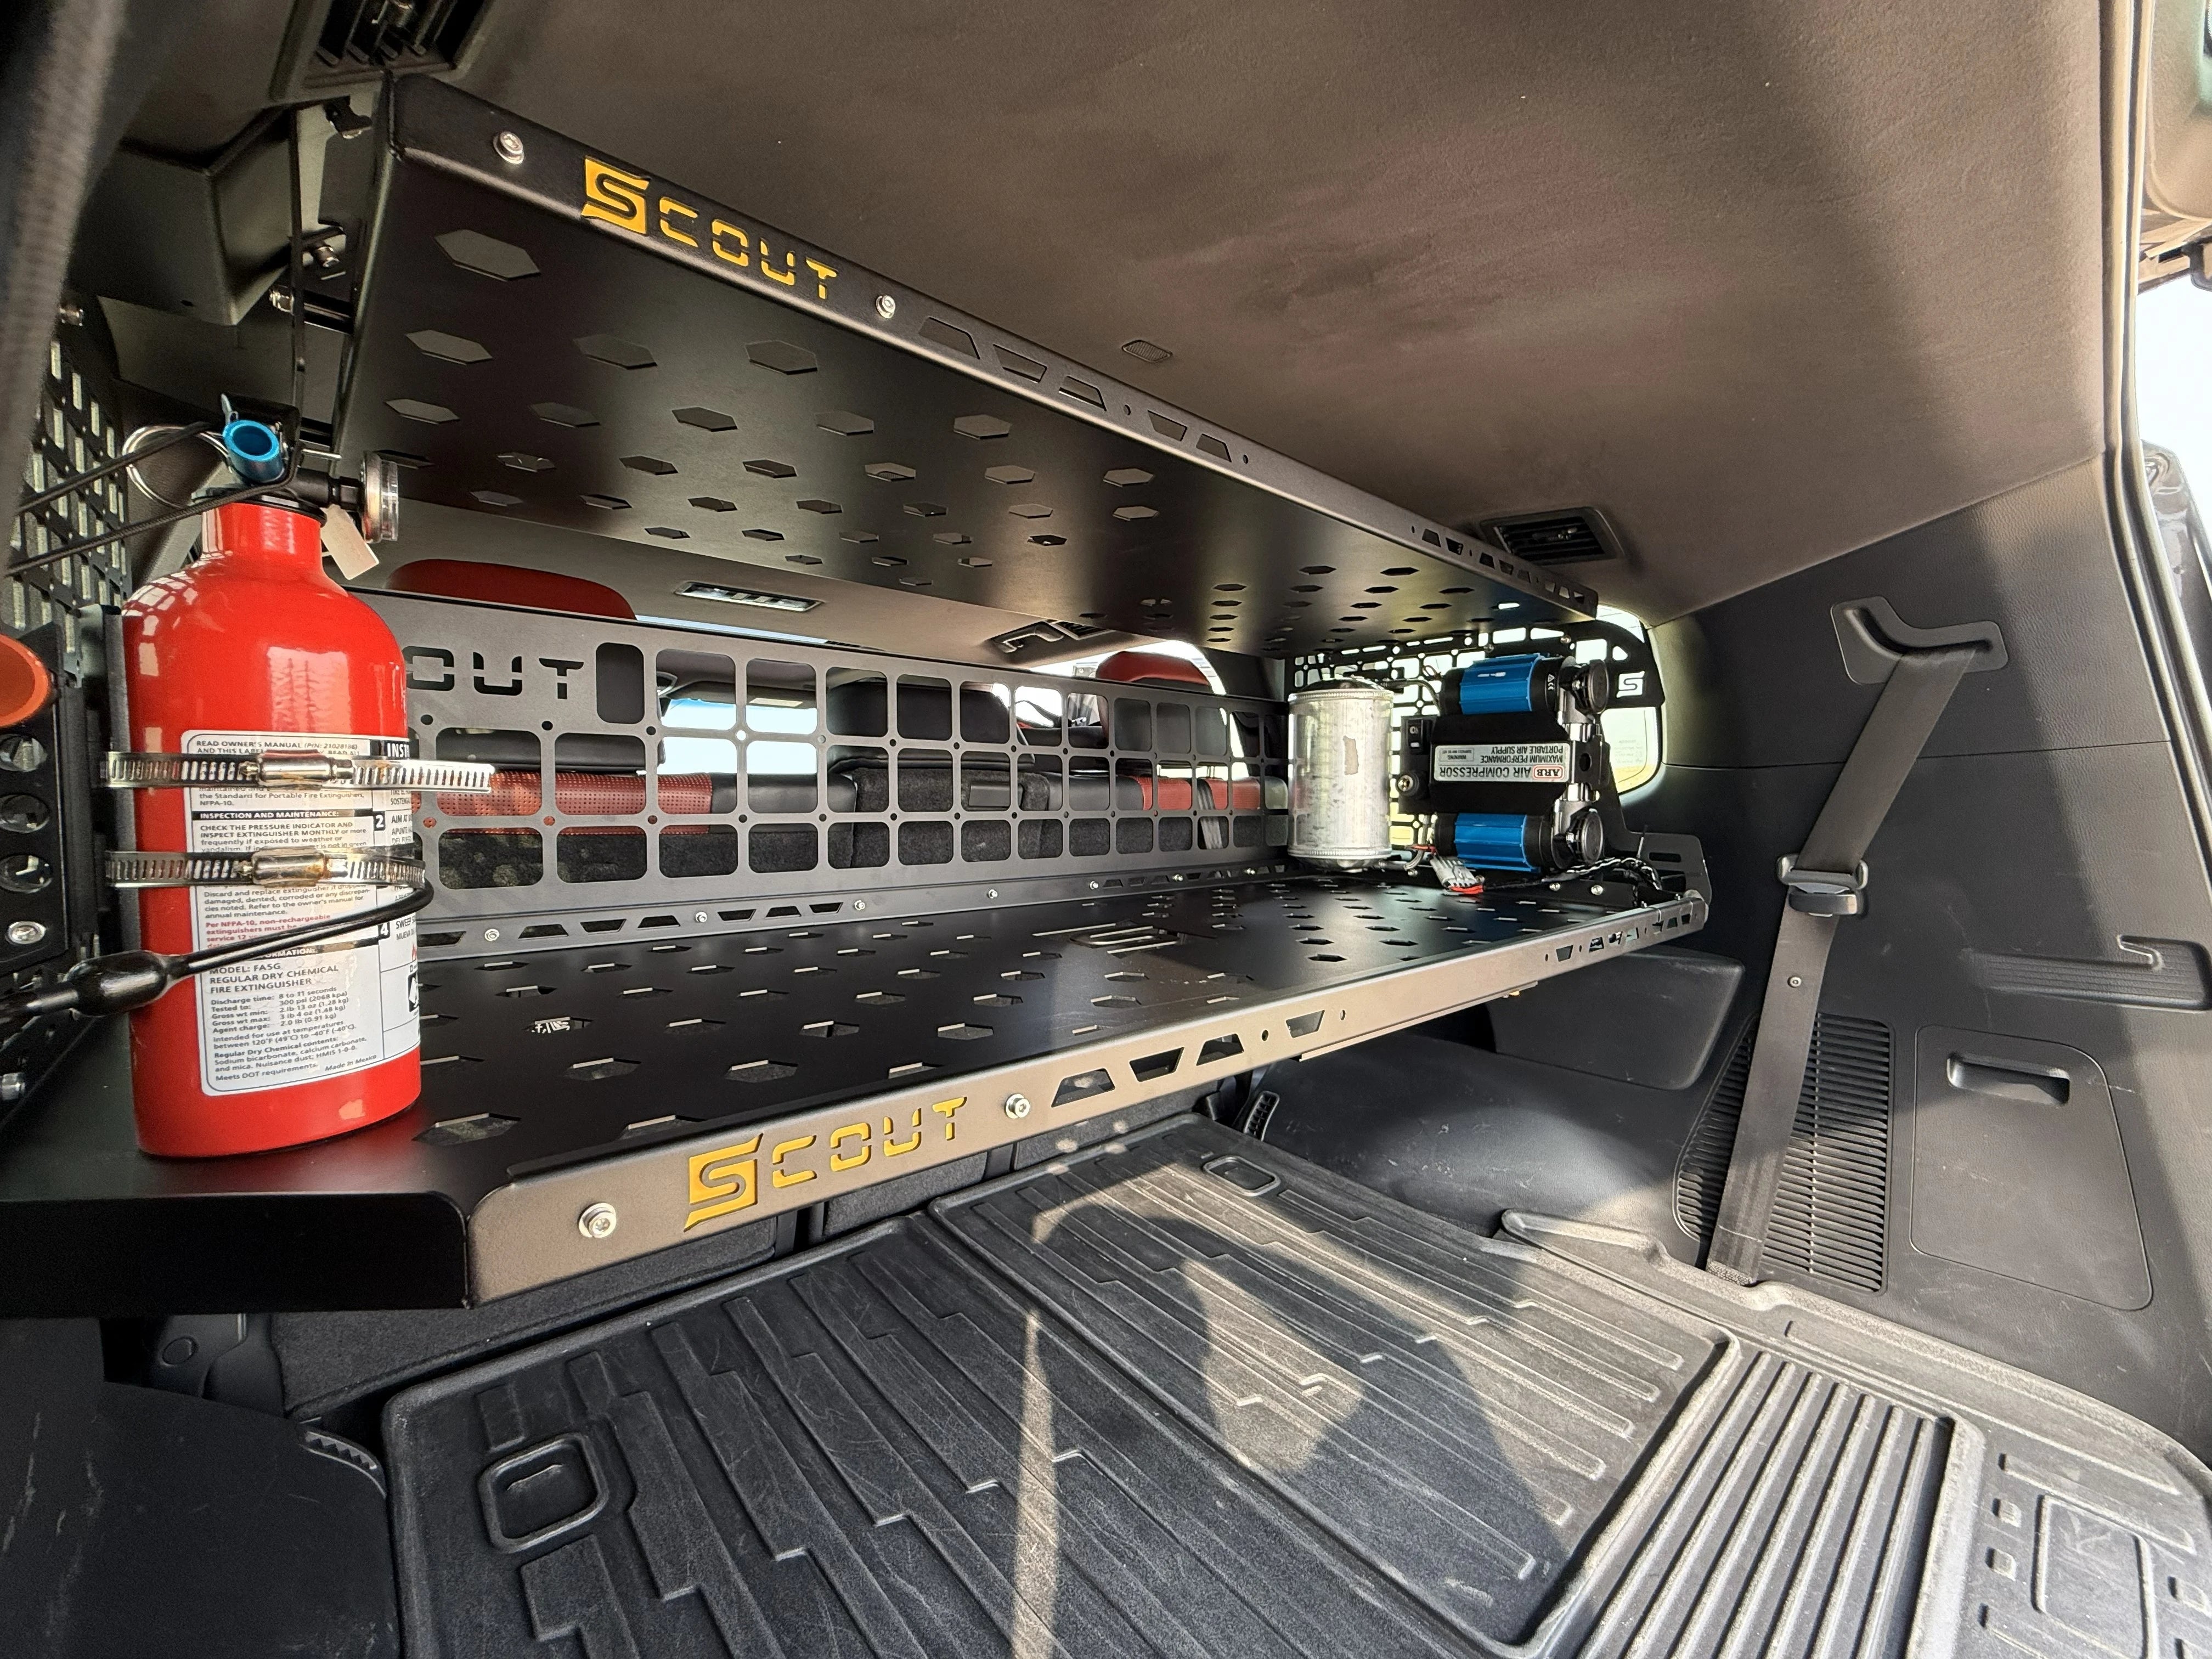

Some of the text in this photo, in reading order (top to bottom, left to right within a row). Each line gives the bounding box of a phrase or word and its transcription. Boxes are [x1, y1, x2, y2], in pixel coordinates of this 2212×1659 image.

[581, 157, 838, 300] SCOUT
[1480, 755, 1527, 763] PERFORMANCE
[1440, 767, 1510, 778] COMPRESSOR
[1513, 767, 1531, 777] AIR
[375, 815, 384, 828] 2
[283, 885, 329, 894] extinguisher
[259, 915, 330, 924] non-rechargeable
[380, 922, 388, 936] 4
[209, 966, 250, 975] MODEL:
[210, 965, 339, 984] REGULAR DRY CHEMICAL
[234, 978, 312, 992] EXTINGUISHER
[307, 986, 337, 995] seconds
[309, 994, 330, 1002] (2068
[332, 990, 348, 998] kpa)
[213, 1034, 250, 1042] Intended
[292, 1021, 343, 1033] temperatures
[215, 1050, 246, 1058] Regular
[264, 1042, 301, 1053] Chemical
[303, 1036, 338, 1047] contents:
[247, 1051, 298, 1062] bicarbonate,
[300, 1045, 329, 1054] calcium
[331, 1037, 367, 1048] carbonate,
[256, 1058, 292, 1068] Nuisance
[316, 1049, 336, 1058] HMIS
[325, 1054, 377, 1071] Made Mexico
[262, 1063, 318, 1076] requirements.
[684, 1096, 967, 1232] SCOUT
